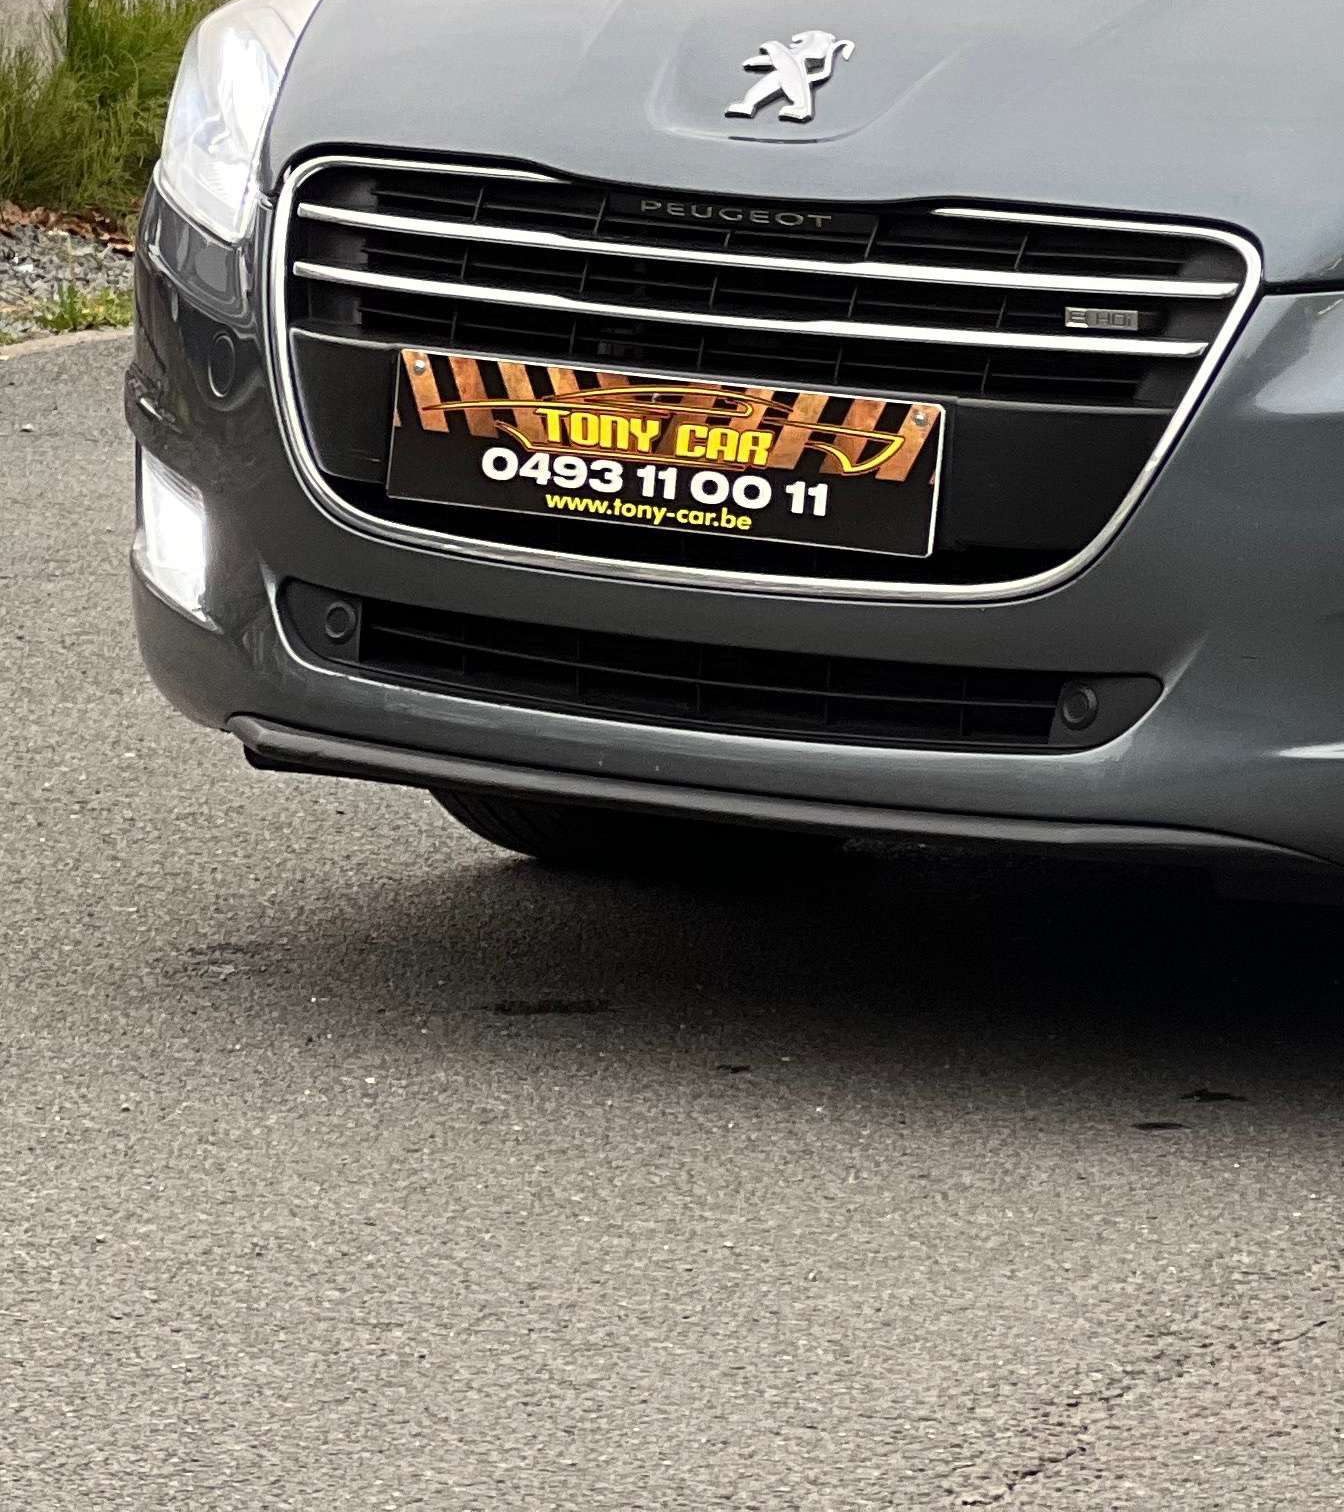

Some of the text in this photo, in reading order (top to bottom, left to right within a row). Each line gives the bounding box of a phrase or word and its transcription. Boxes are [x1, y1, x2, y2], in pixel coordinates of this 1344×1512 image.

[640, 199, 832, 229] PEUGEOT
[534, 407, 774, 467] TONY CAR
[481, 446, 829, 517] 0493 11 00 11
[545, 492, 753, 532] www.tony-car.be
